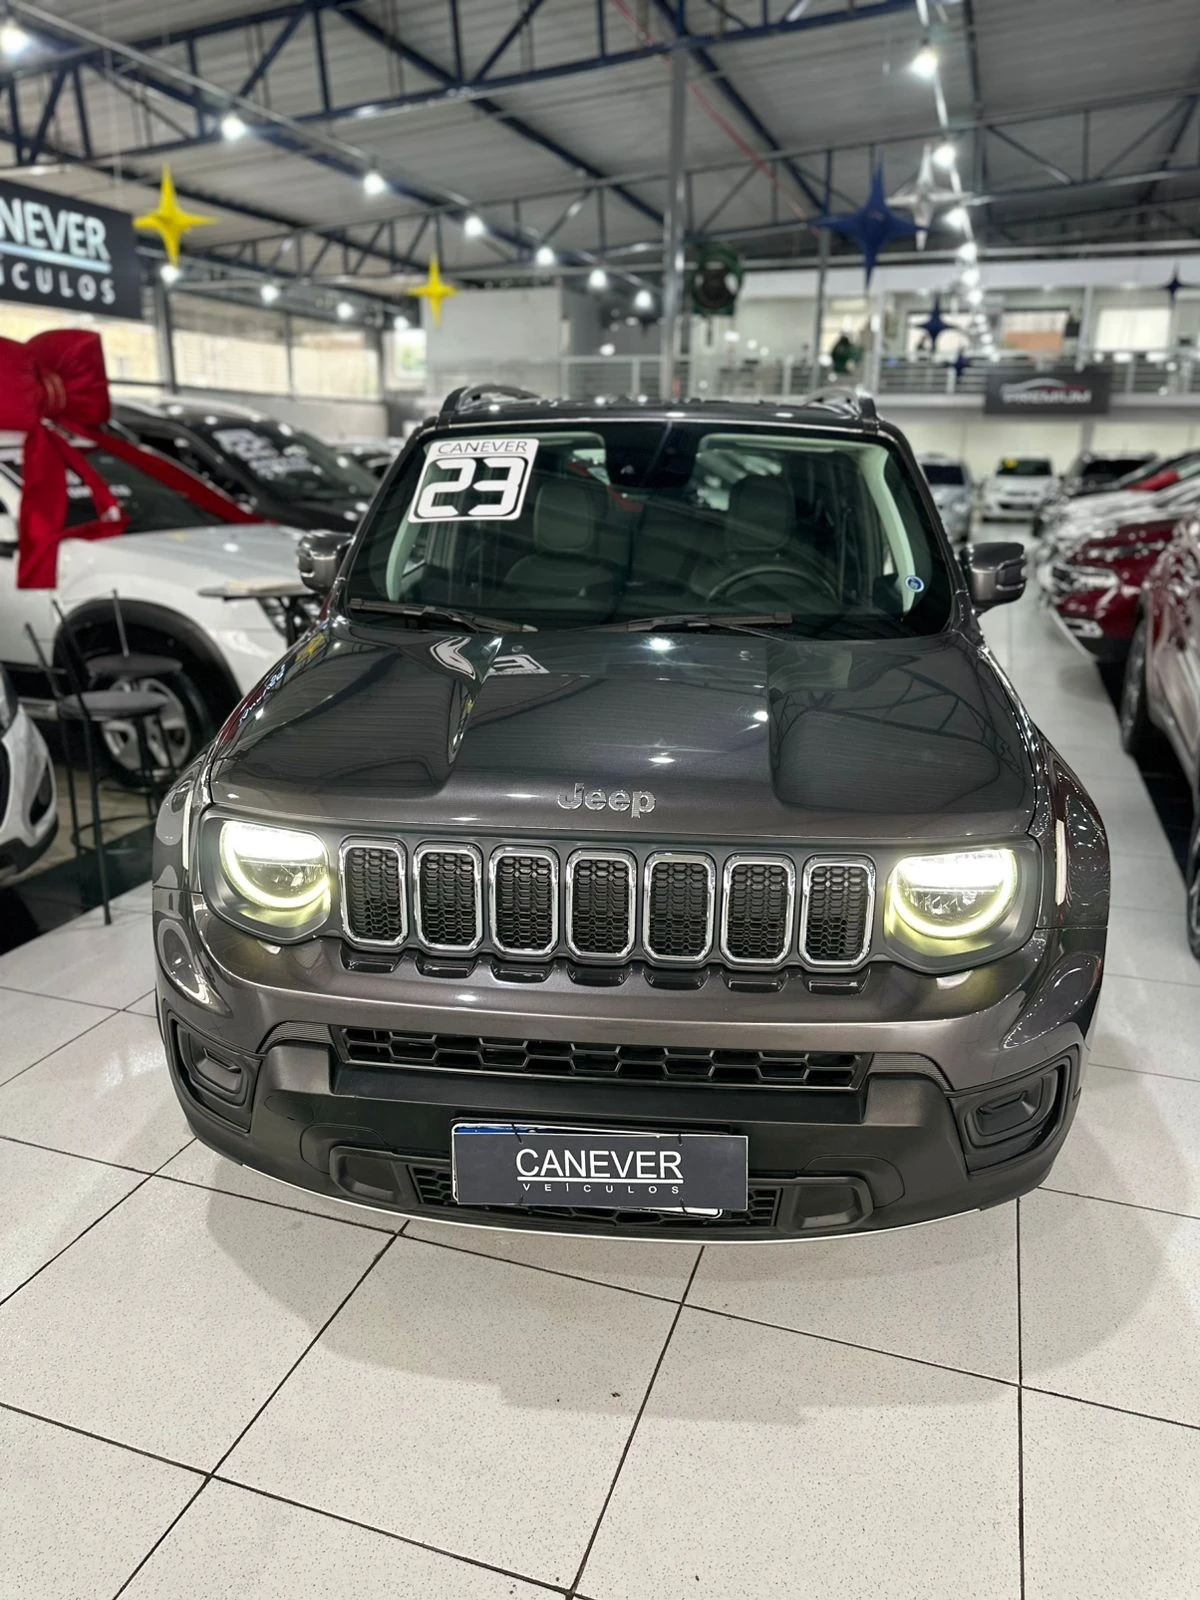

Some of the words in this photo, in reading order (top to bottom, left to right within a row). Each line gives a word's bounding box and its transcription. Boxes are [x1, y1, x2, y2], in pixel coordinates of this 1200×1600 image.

[438, 441, 528, 454] CANEVER
[417, 457, 526, 518] 23
[557, 782, 656, 818] Jeep
[515, 1149, 683, 1179] CANEVER
